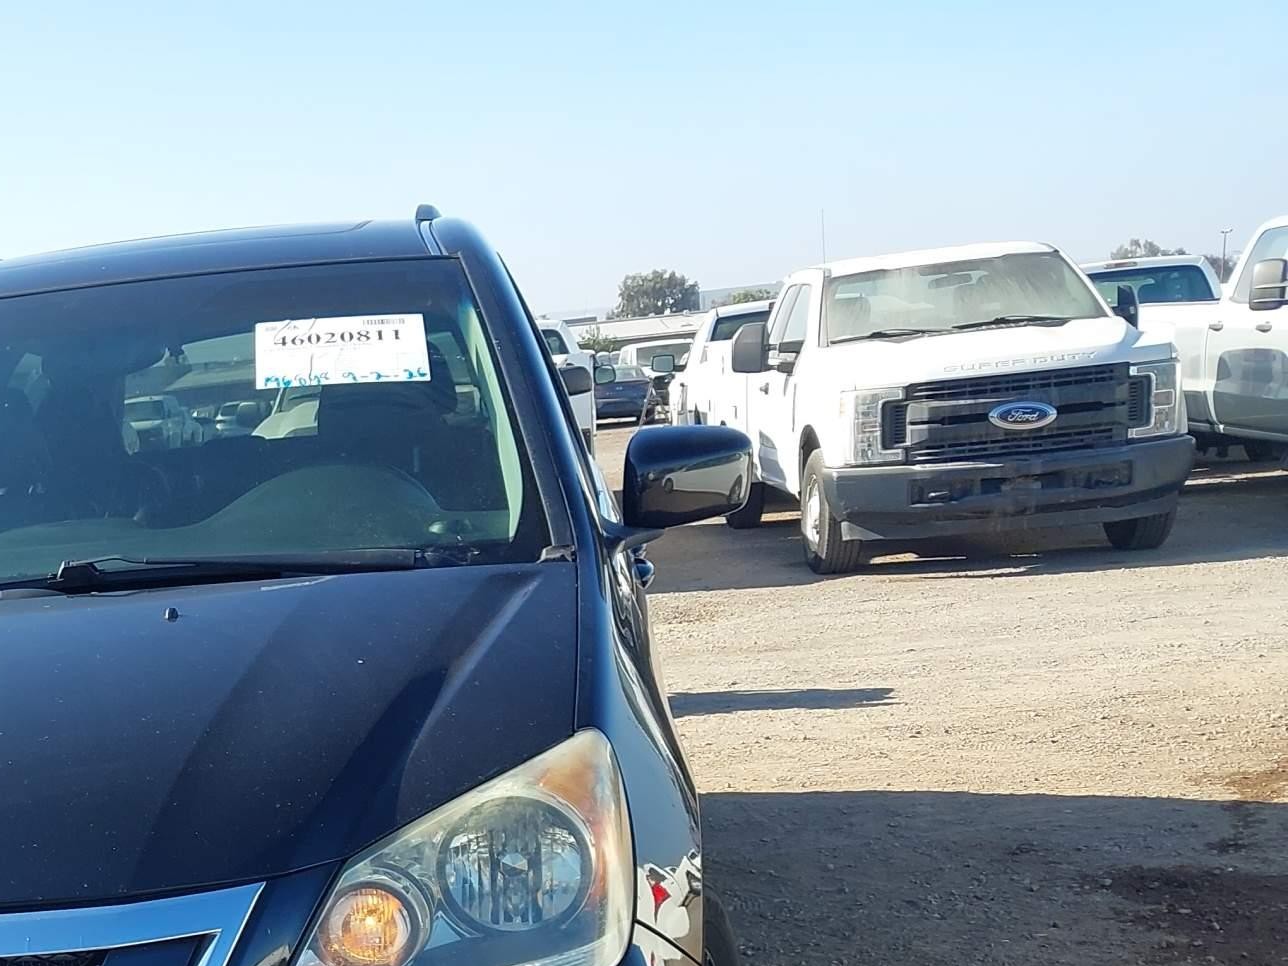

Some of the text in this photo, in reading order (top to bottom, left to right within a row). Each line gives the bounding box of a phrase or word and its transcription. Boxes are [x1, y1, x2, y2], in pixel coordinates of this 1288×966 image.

[274, 329, 400, 347] 46020811
[943, 350, 1097, 373] SUPER DUTY
[1008, 408, 1040, 422] Ford
